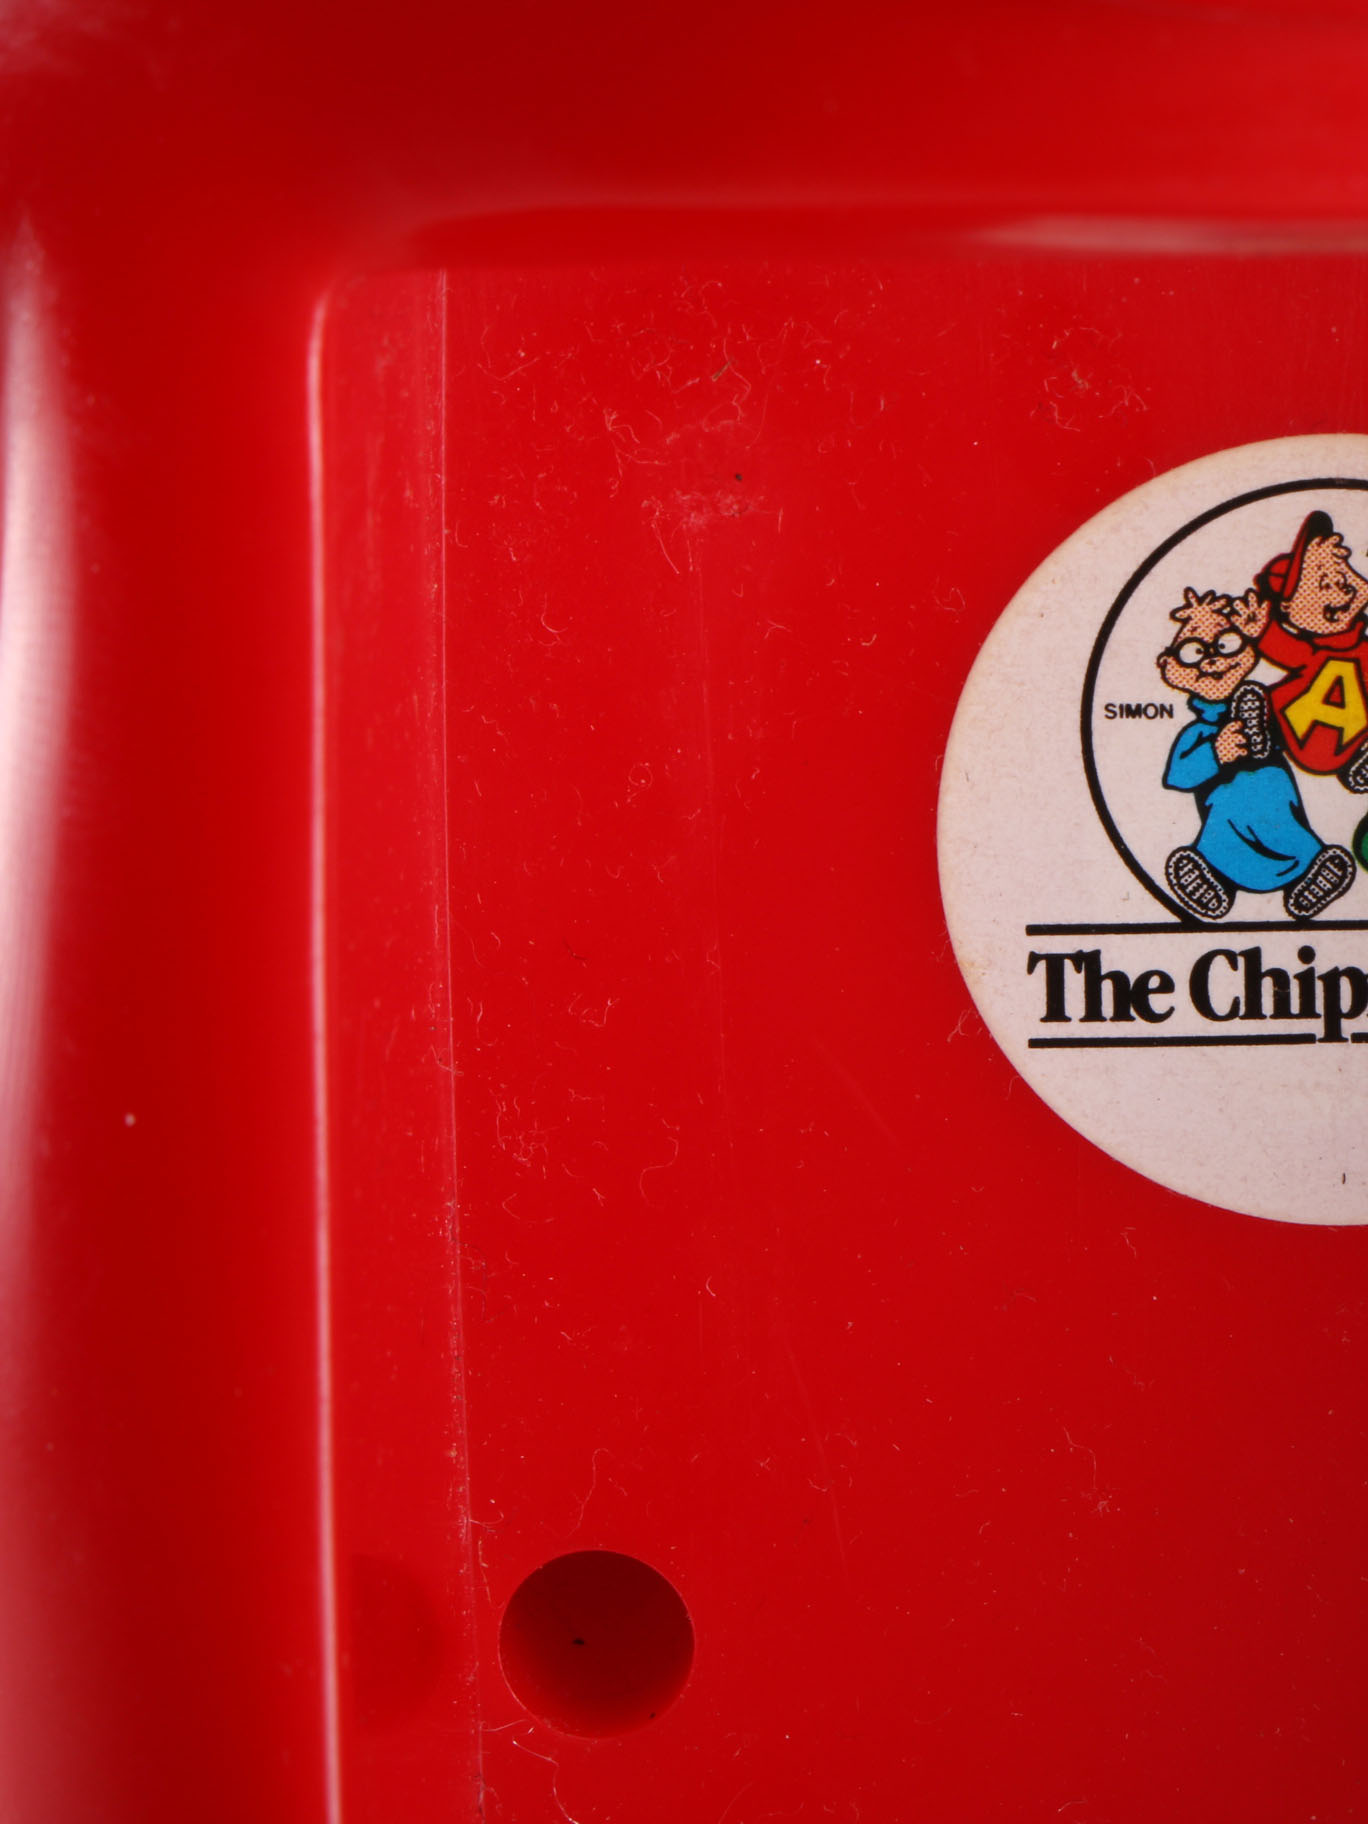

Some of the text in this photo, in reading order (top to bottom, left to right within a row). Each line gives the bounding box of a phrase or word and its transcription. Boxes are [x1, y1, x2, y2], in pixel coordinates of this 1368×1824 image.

[1104, 703, 1174, 719] SIMON
[1284, 660, 1368, 746] A
[1026, 949, 1175, 1023] The
